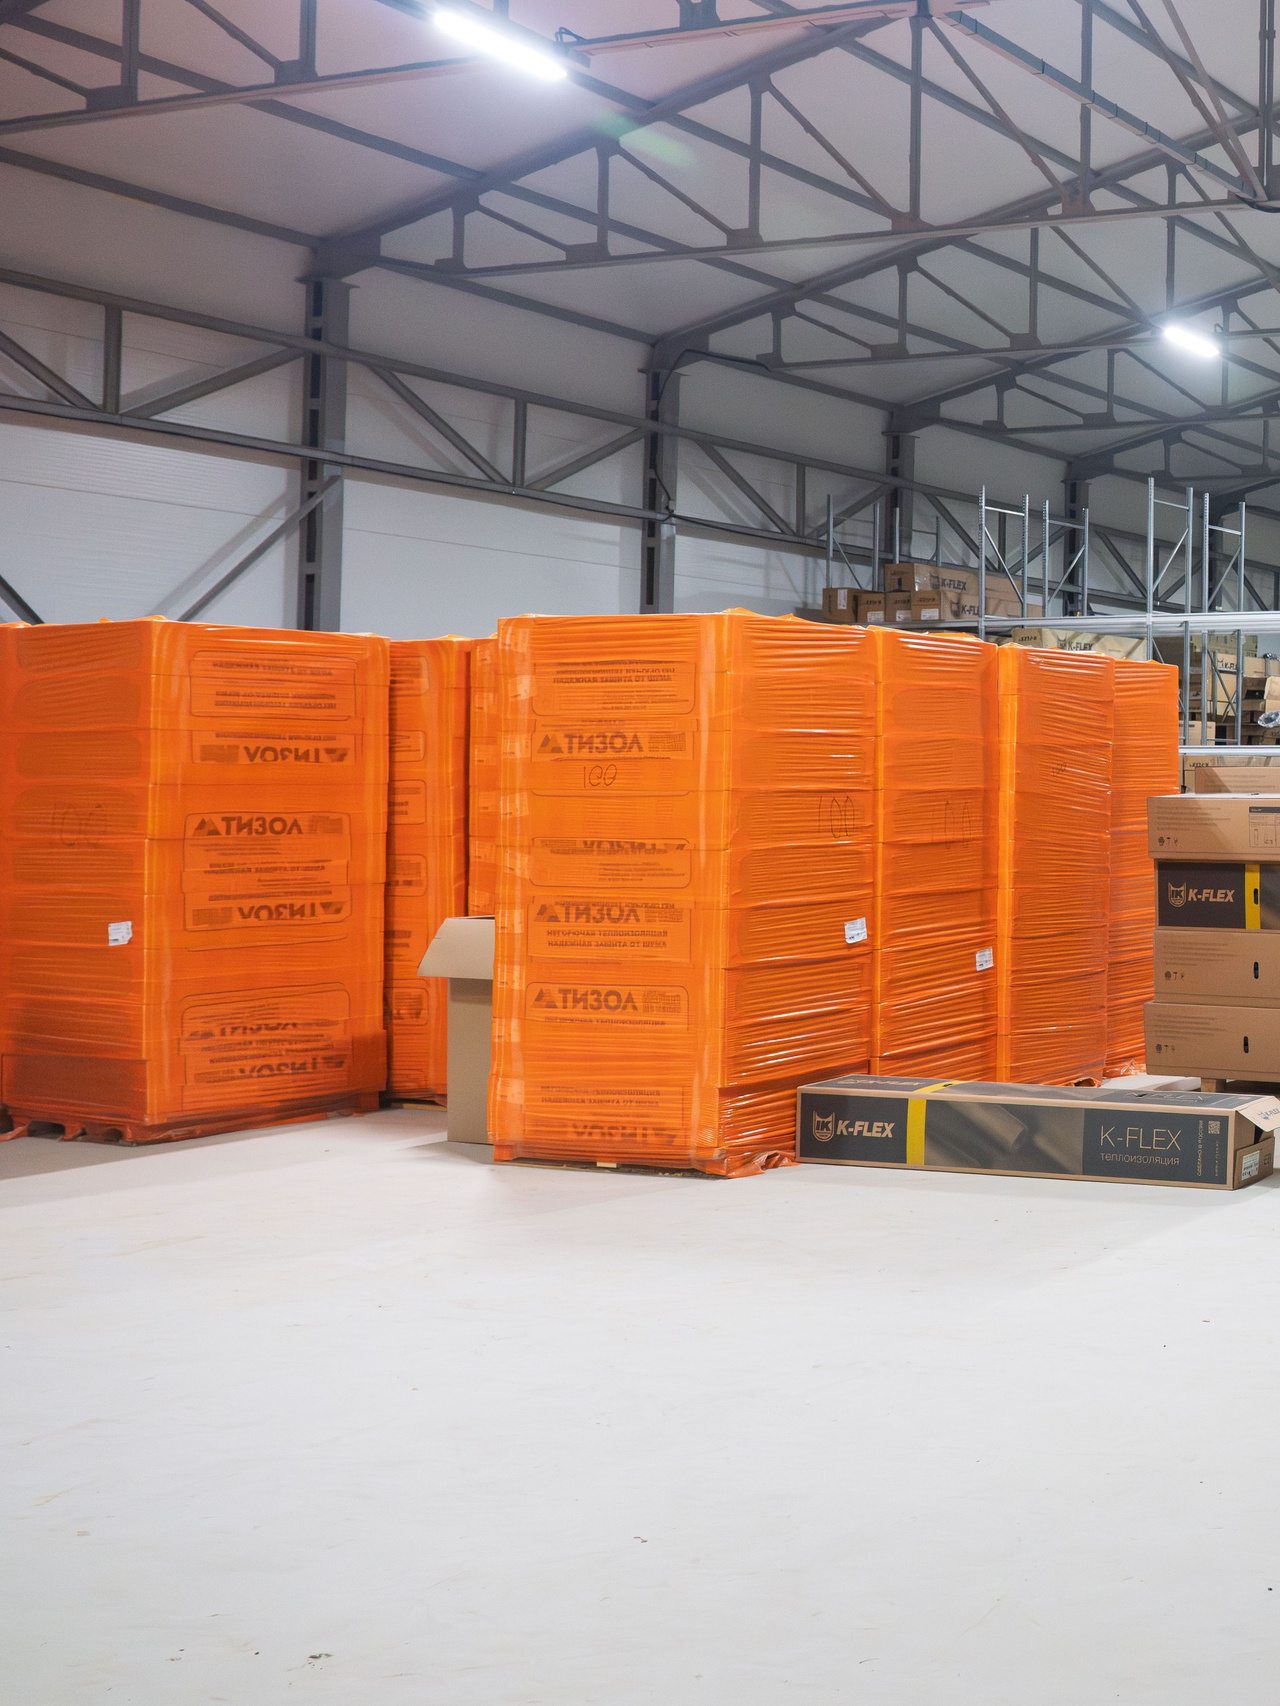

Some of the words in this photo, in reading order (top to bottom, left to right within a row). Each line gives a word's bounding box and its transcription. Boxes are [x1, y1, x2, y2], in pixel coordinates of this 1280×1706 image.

[941, 578, 967, 591] K-FLEX
[961, 605, 980, 615] K-FL
[564, 733, 643, 754] ТИЗОЛ
[221, 817, 303, 835] ТИЗОЛ
[1188, 889, 1235, 902] K-FLEX
[558, 988, 638, 1011] ТИЗОЛ
[836, 1120, 895, 1138] K-FLEX
[1100, 1125, 1181, 1150] K-FLEX
[1100, 1152, 1180, 1166] теплоизоляция
